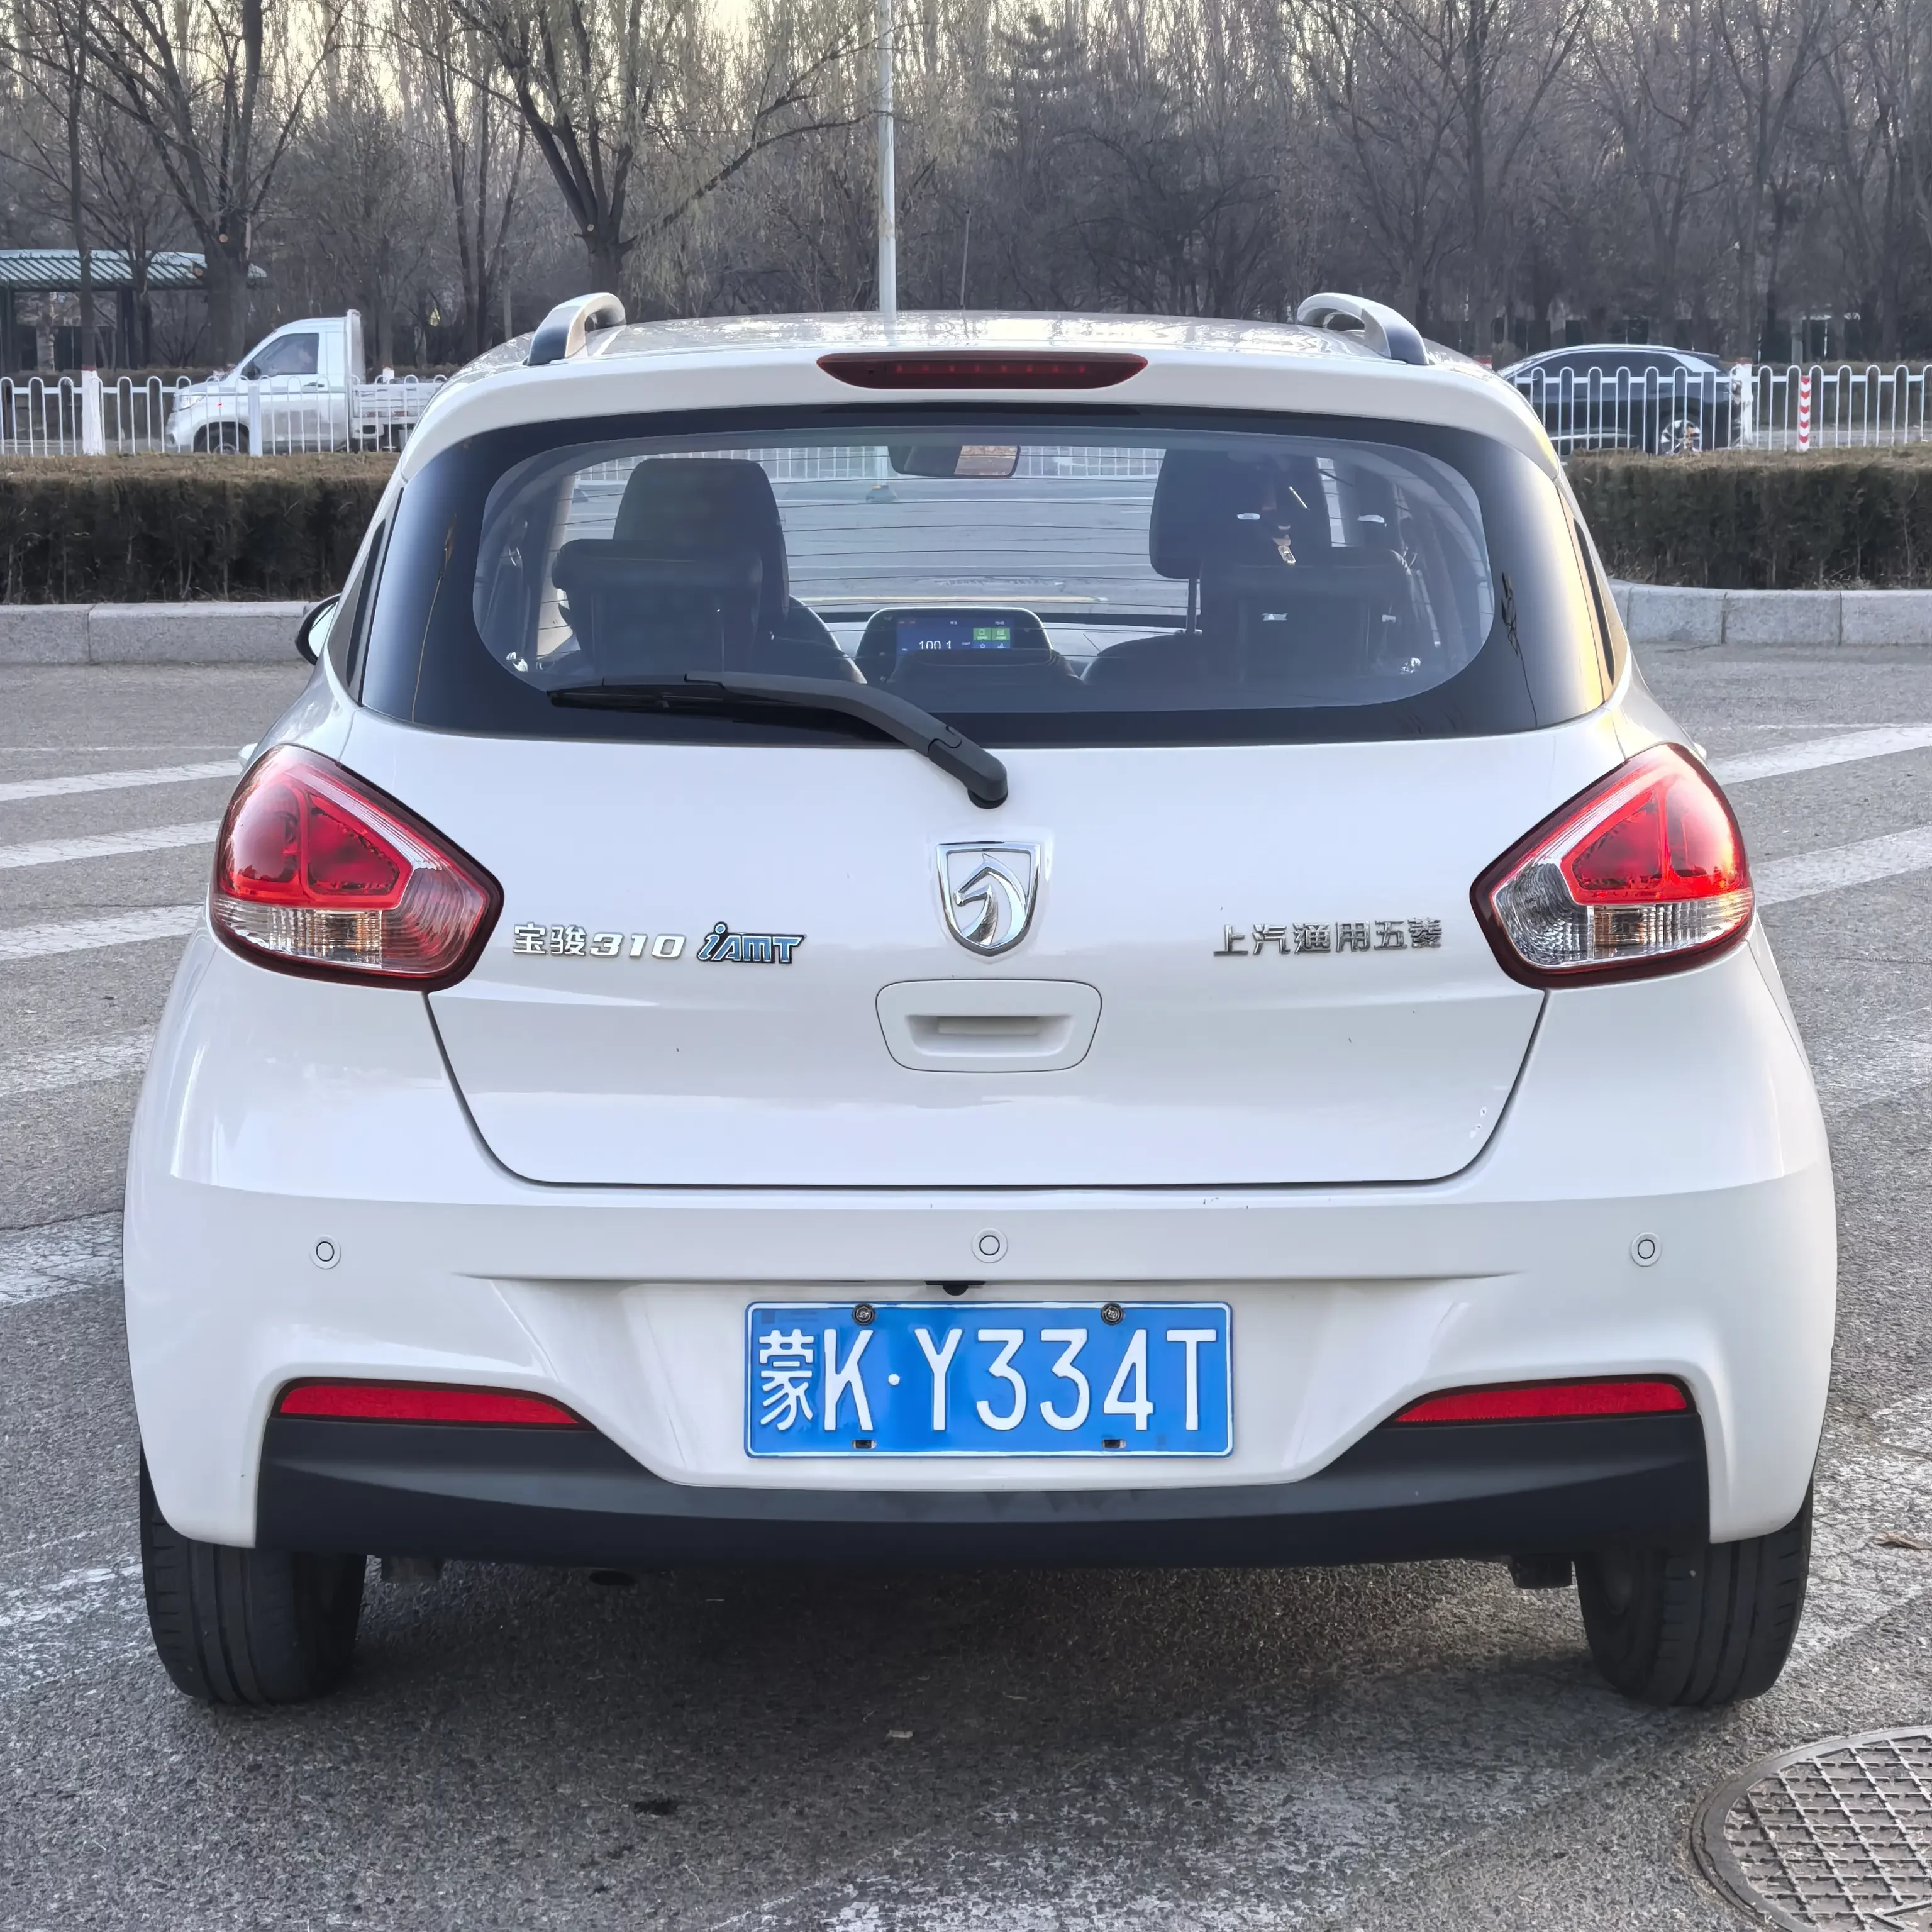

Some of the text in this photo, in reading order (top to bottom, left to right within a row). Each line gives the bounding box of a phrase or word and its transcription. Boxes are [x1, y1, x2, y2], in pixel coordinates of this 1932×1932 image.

[697, 921, 807, 964] iAMT
[1213, 917, 1443, 956] 上汽通用五菱
